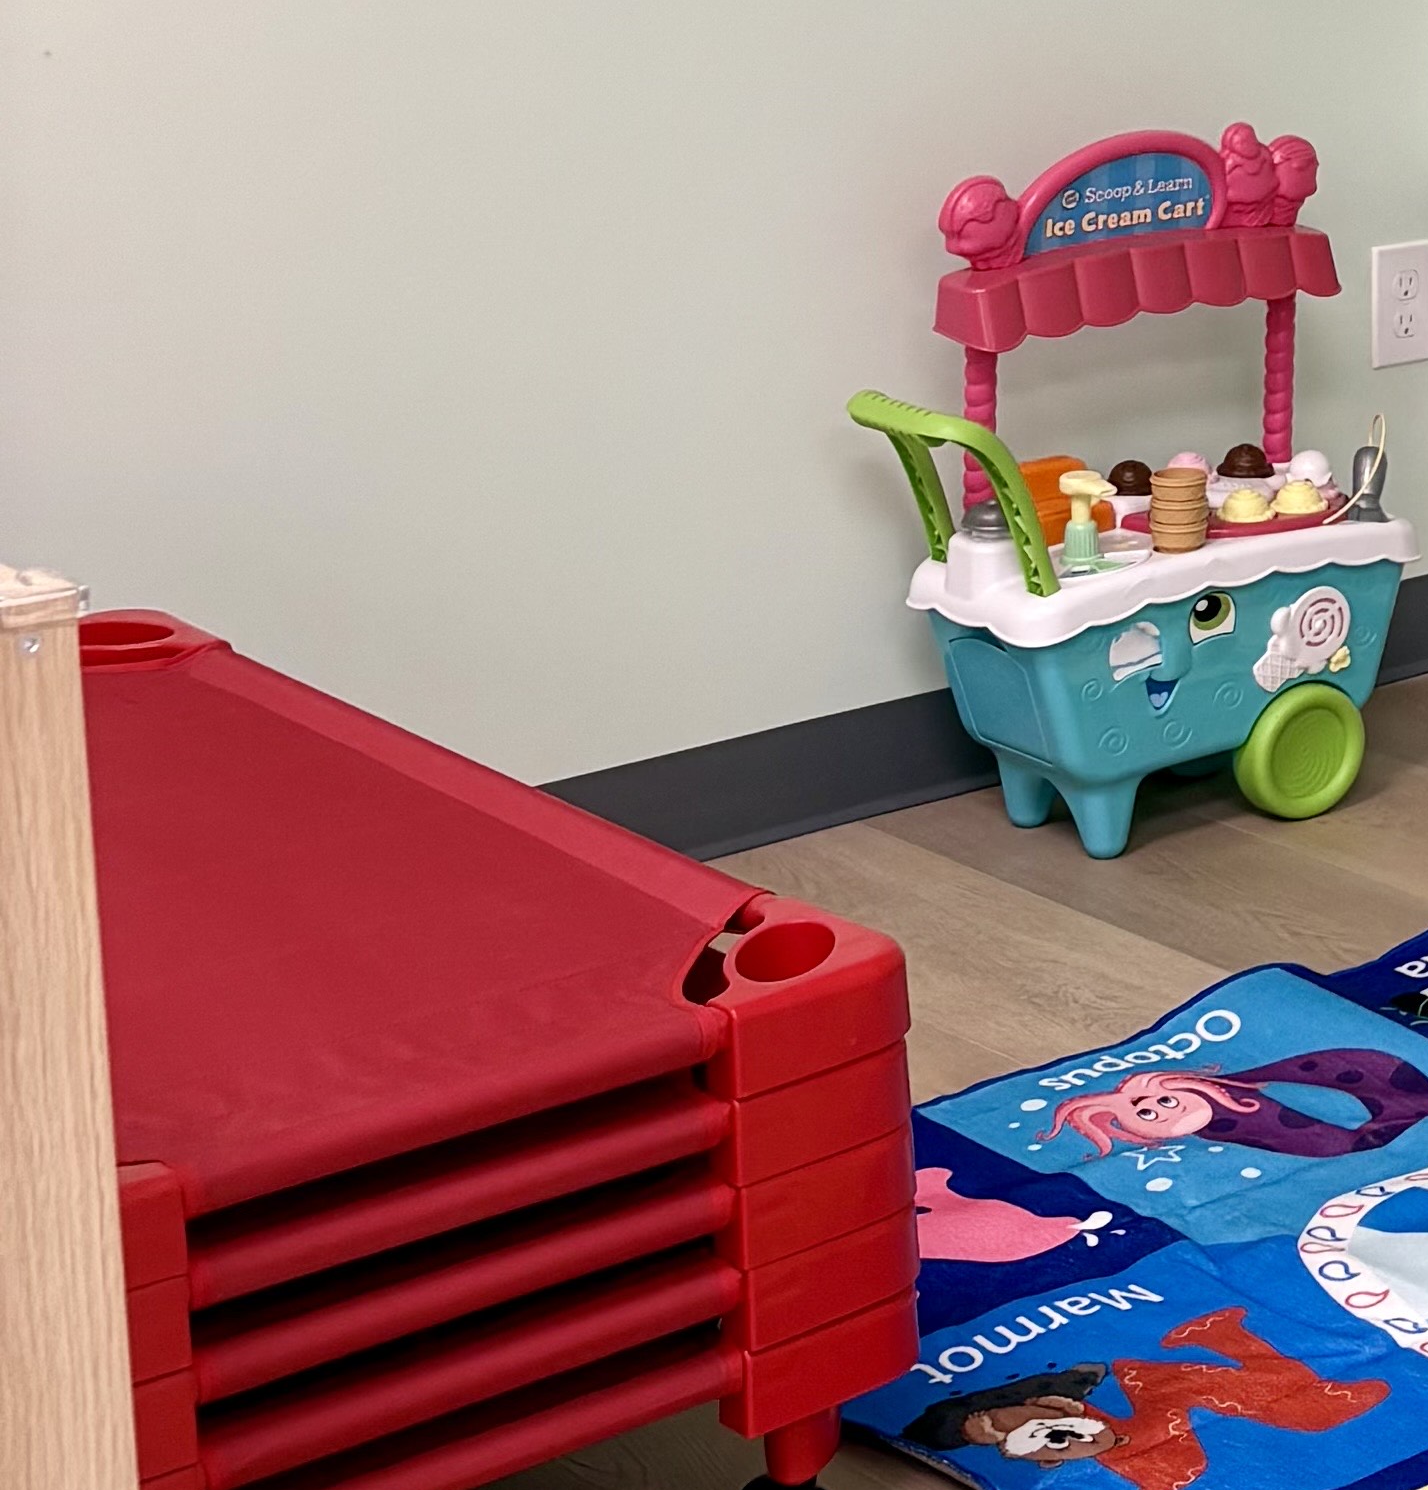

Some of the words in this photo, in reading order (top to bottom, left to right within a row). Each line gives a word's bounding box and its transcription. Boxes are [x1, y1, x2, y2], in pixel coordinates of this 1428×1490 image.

[1045, 218, 1076, 238] Ice
[1081, 207, 1152, 233] Cream
[1157, 197, 1205, 221] Cart
[1084, 184, 1132, 204] Scoop
[1133, 179, 1145, 196] &
[1147, 177, 1193, 194] Learn
[1037, 1008, 1242, 1092] Octopus
[909, 1283, 1164, 1386] Marmot
